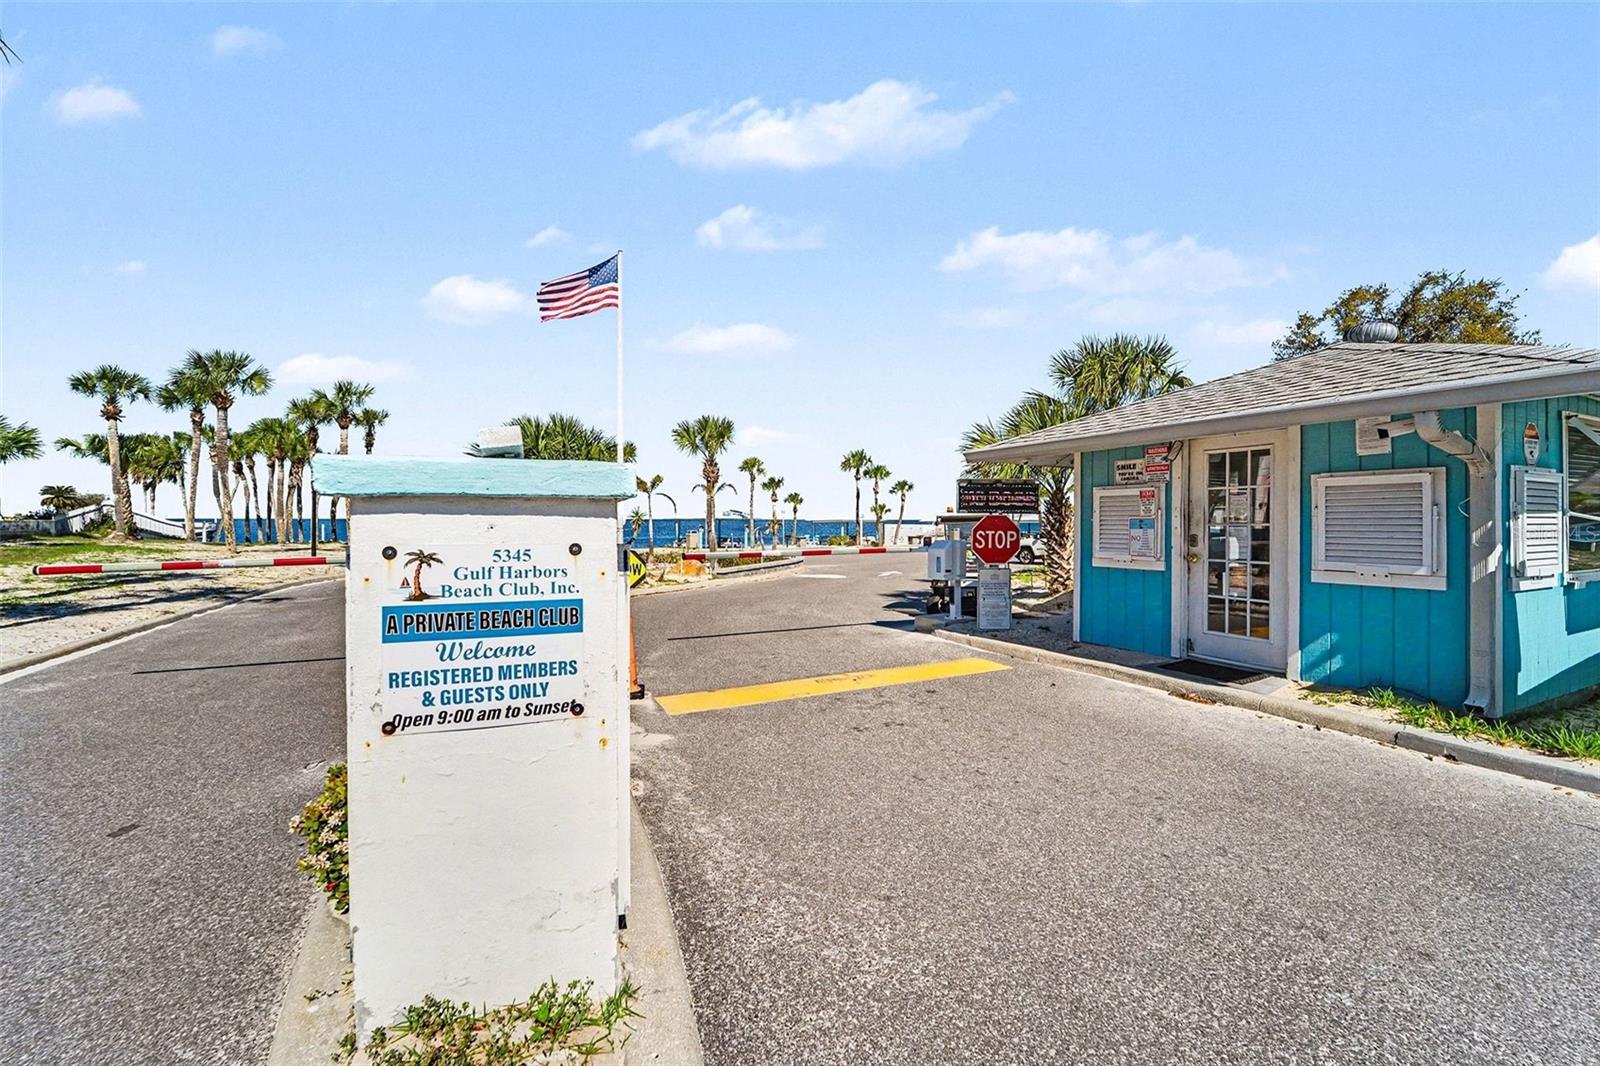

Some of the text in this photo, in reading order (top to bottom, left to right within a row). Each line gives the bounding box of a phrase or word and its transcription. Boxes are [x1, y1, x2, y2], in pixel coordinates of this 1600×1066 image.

[975, 530, 1017, 549] STOP
[492, 549, 532, 563] 5345
[453, 565, 568, 581] Gulf Harbors
[440, 581, 580, 598] Beach Club, Inc.
[386, 607, 579, 635] A PRIVATE BEACH CLUB
[435, 640, 537, 662] Welcome
[388, 660, 578, 689] REGISTERED MEMBERS
[421, 682, 549, 707] & GUESTS ONLY
[392, 698, 576, 731] Open 9:00 am to Sunset
